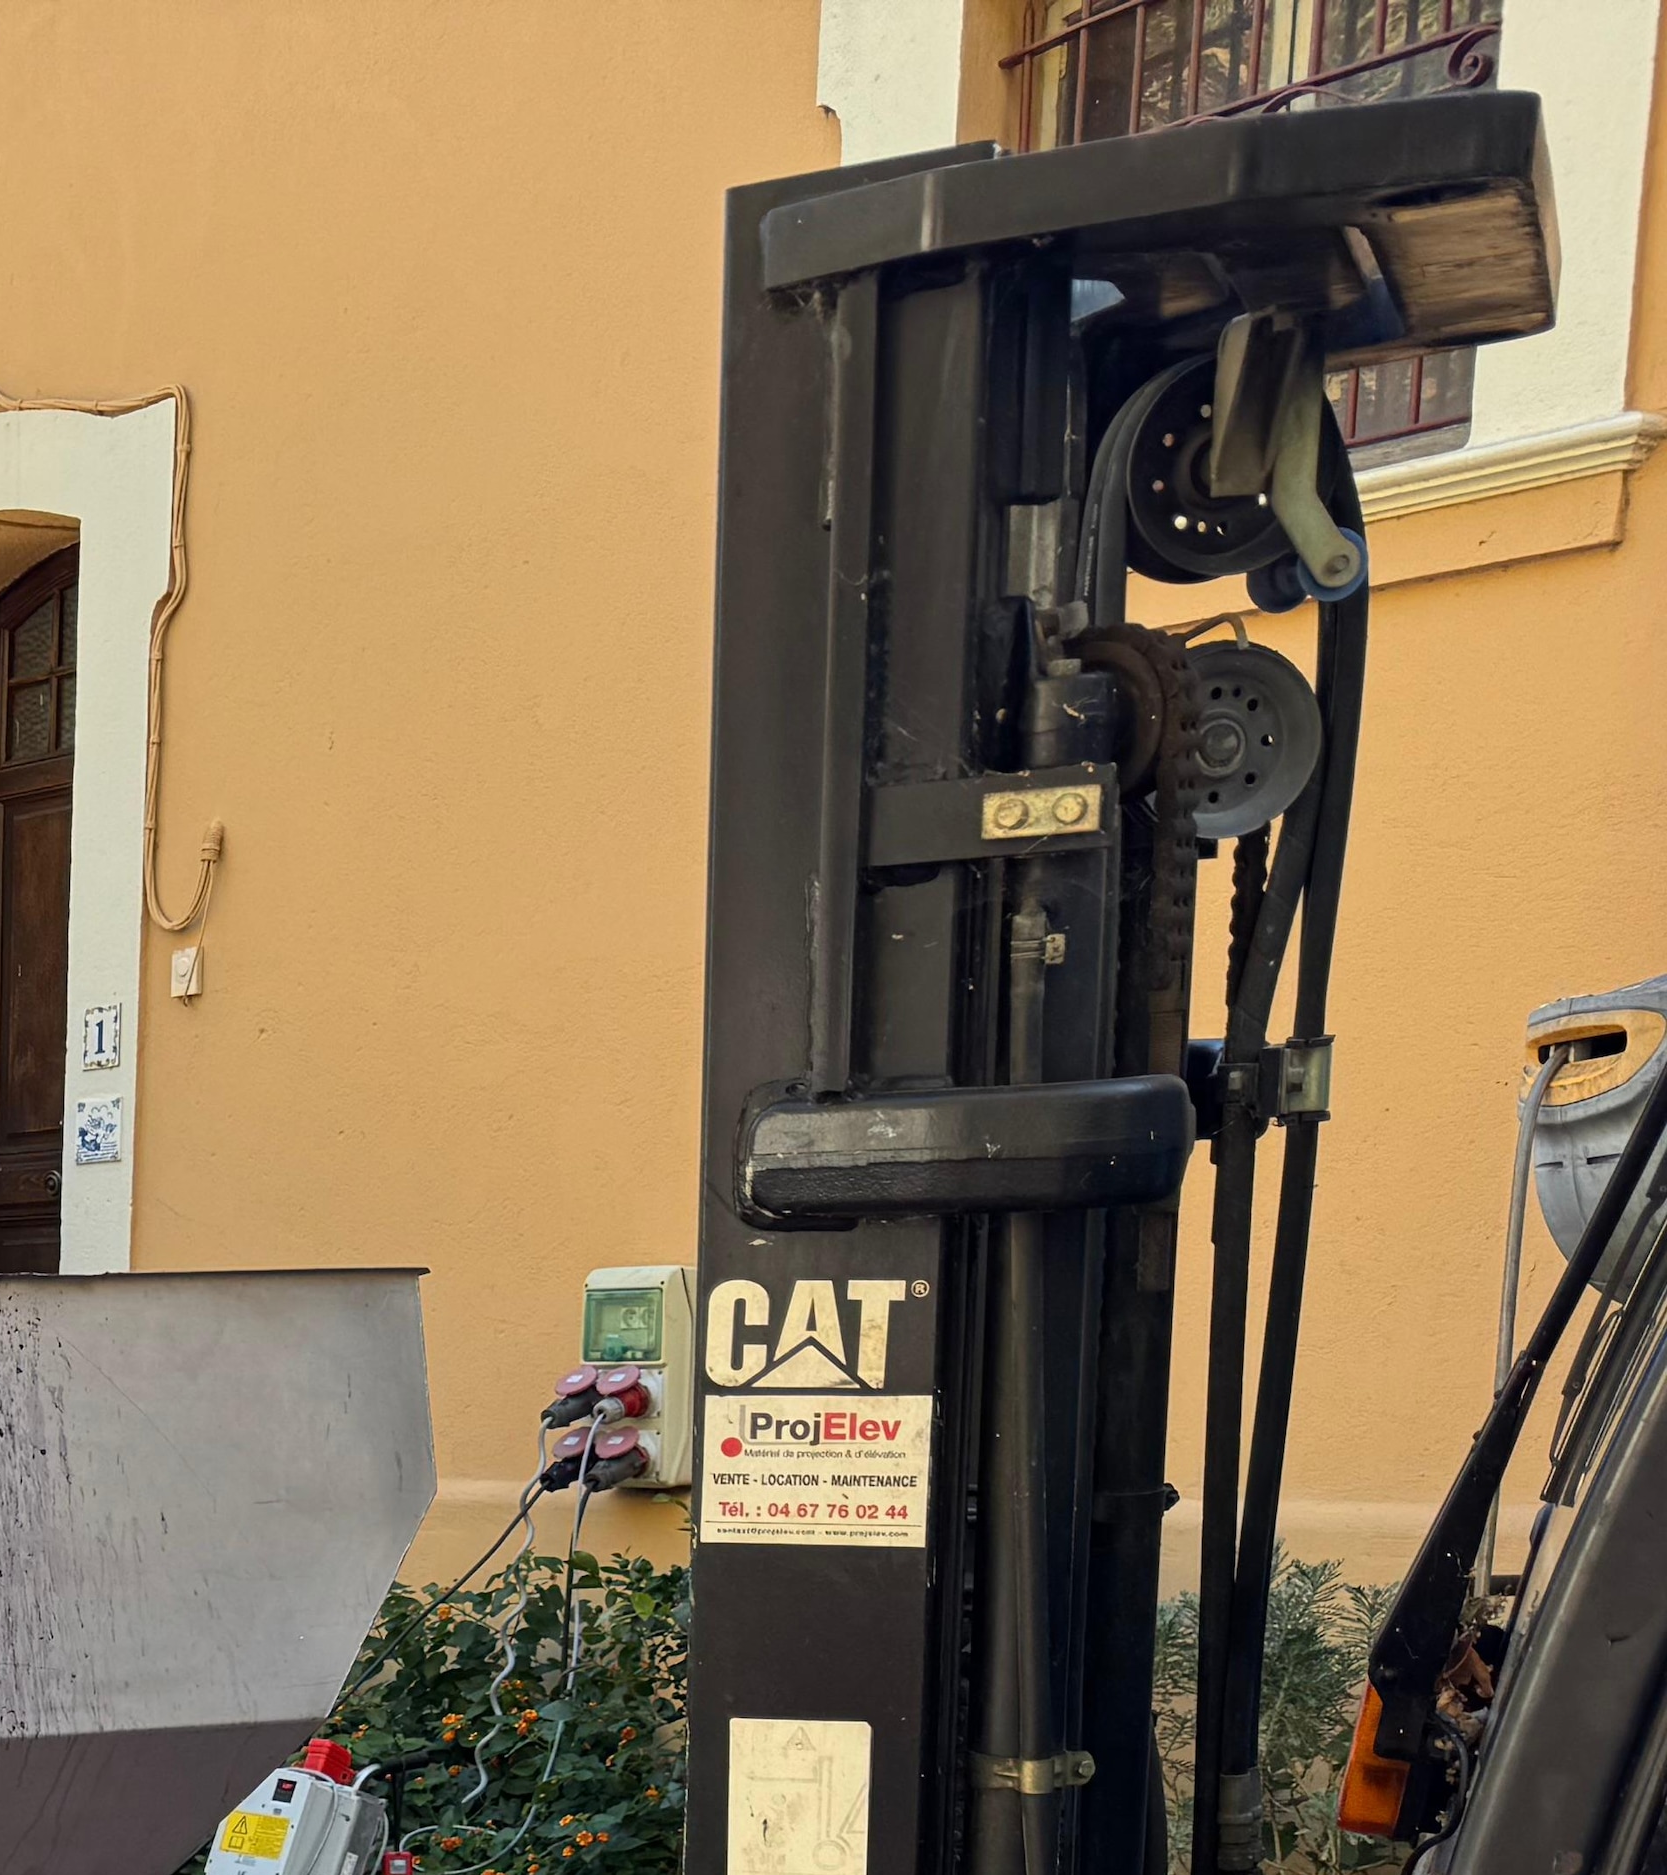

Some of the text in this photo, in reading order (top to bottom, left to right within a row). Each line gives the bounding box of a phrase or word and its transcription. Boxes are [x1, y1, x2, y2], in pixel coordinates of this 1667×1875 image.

[94, 1019, 106, 1055] 1
[705, 1280, 906, 1389] CAT
[749, 1412, 902, 1446] ProjElev
[797, 1449, 843, 1460] projection
[712, 1473, 750, 1485] VENTE
[761, 1473, 819, 1486] LOCATION
[831, 1474, 918, 1487] MAINTENANCE
[718, 1501, 749, 1517] Tél.
[767, 1502, 790, 1517] 04
[796, 1502, 819, 1518] 67
[826, 1503, 850, 1518] 76
[855, 1504, 879, 1519] 02
[885, 1505, 908, 1520] 44
